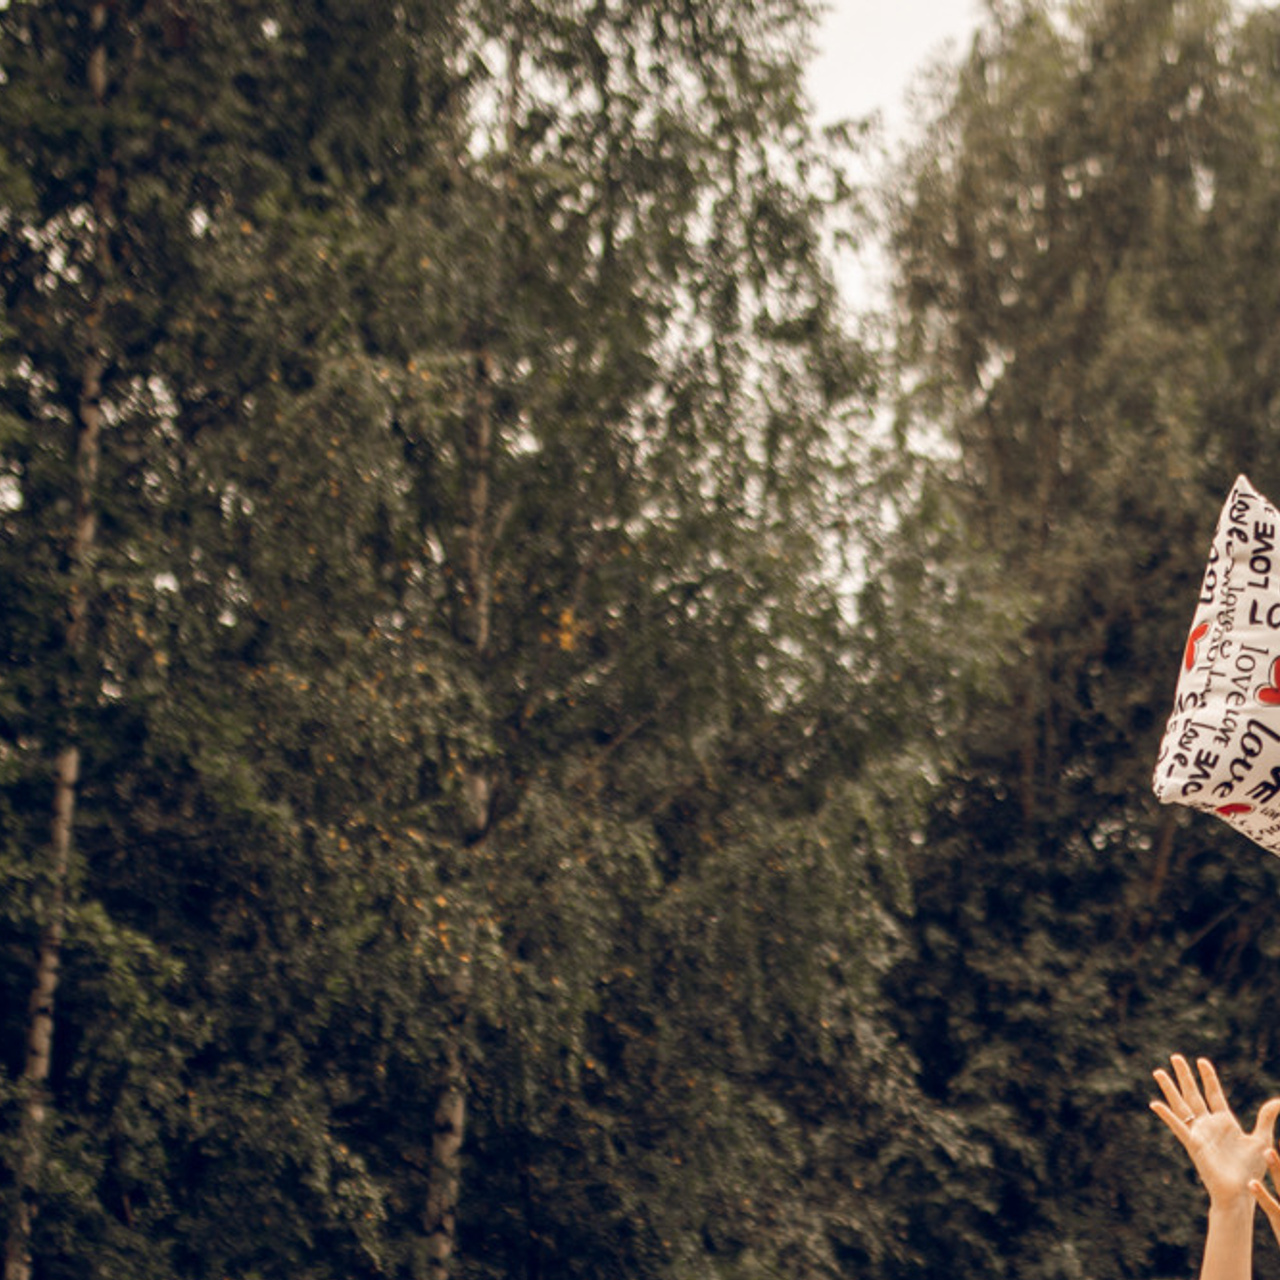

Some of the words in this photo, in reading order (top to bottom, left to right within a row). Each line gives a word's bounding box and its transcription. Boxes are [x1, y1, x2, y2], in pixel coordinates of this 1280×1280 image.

[1247, 521, 1275, 590] LOVE
[1227, 643, 1269, 707] love
[1212, 709, 1241, 749] LOVE
